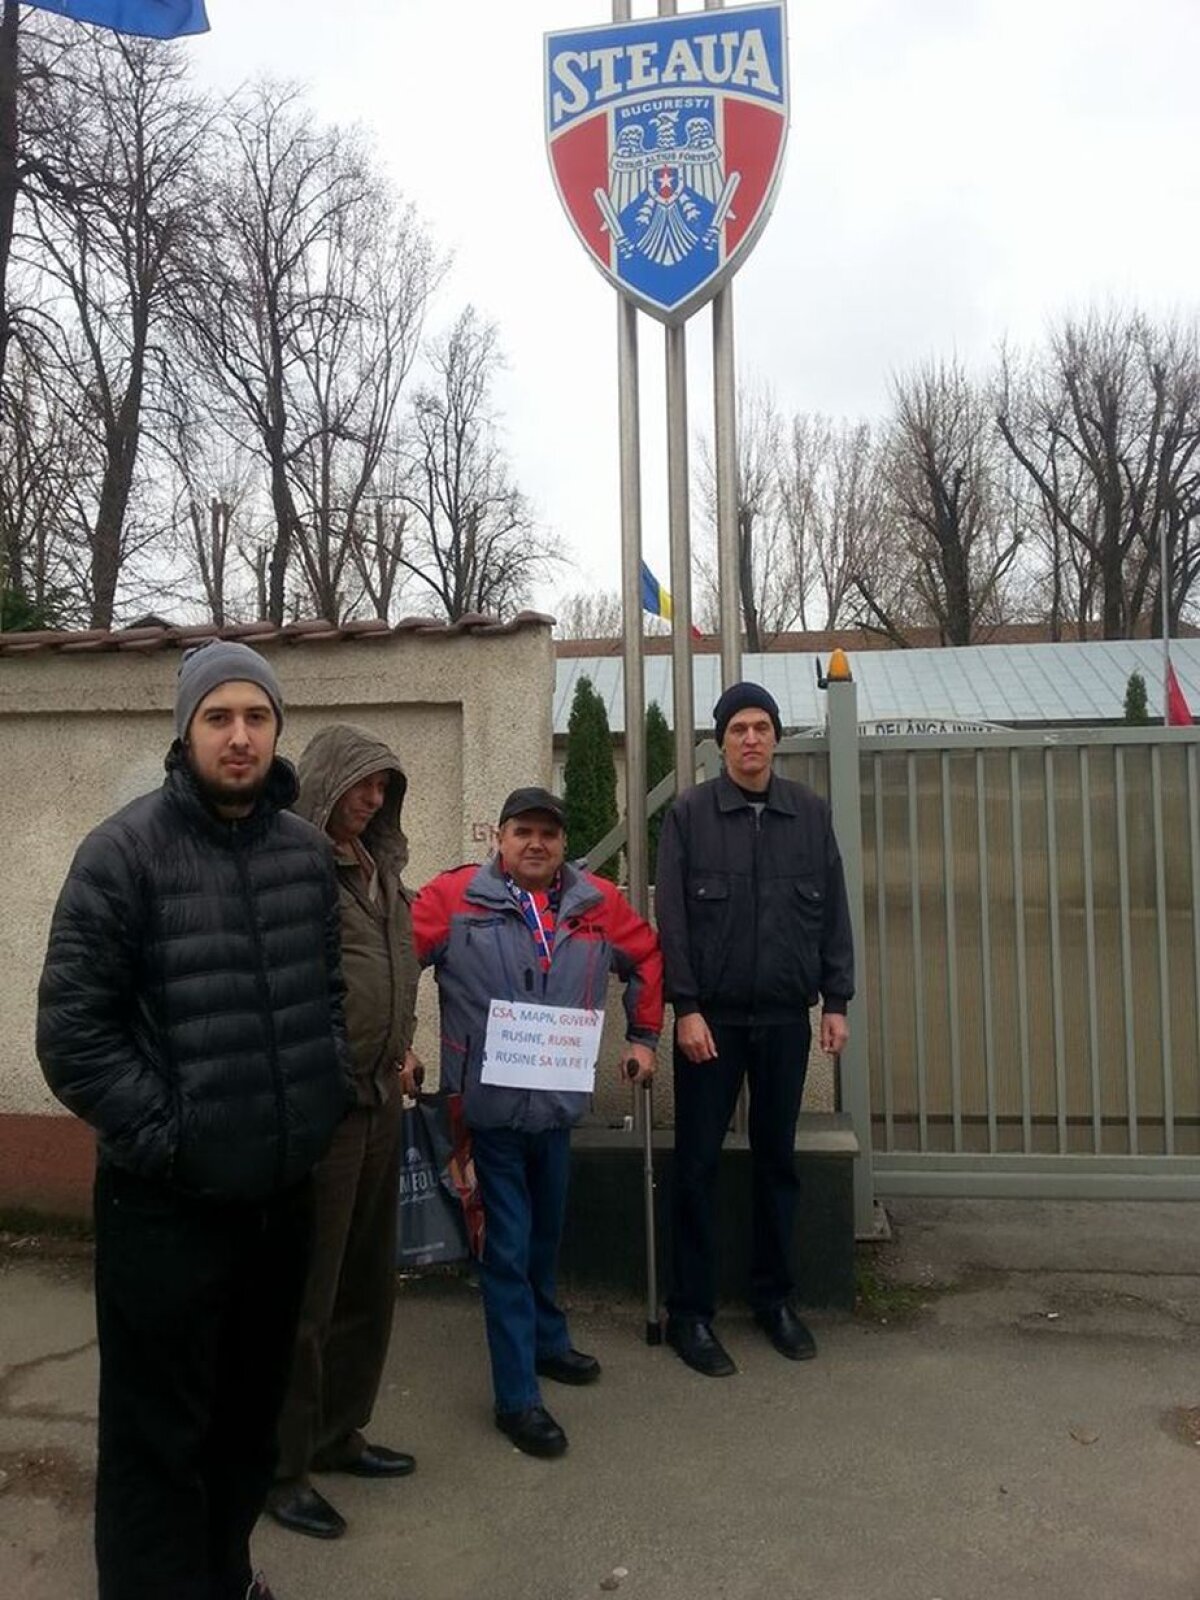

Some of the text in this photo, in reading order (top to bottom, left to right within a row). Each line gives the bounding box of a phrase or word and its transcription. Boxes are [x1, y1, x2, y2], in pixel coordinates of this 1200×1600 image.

[553, 28, 779, 122] STEAUA
[621, 98, 710, 119] BUCURESTI
[495, 1051, 537, 1067] RUSINE
